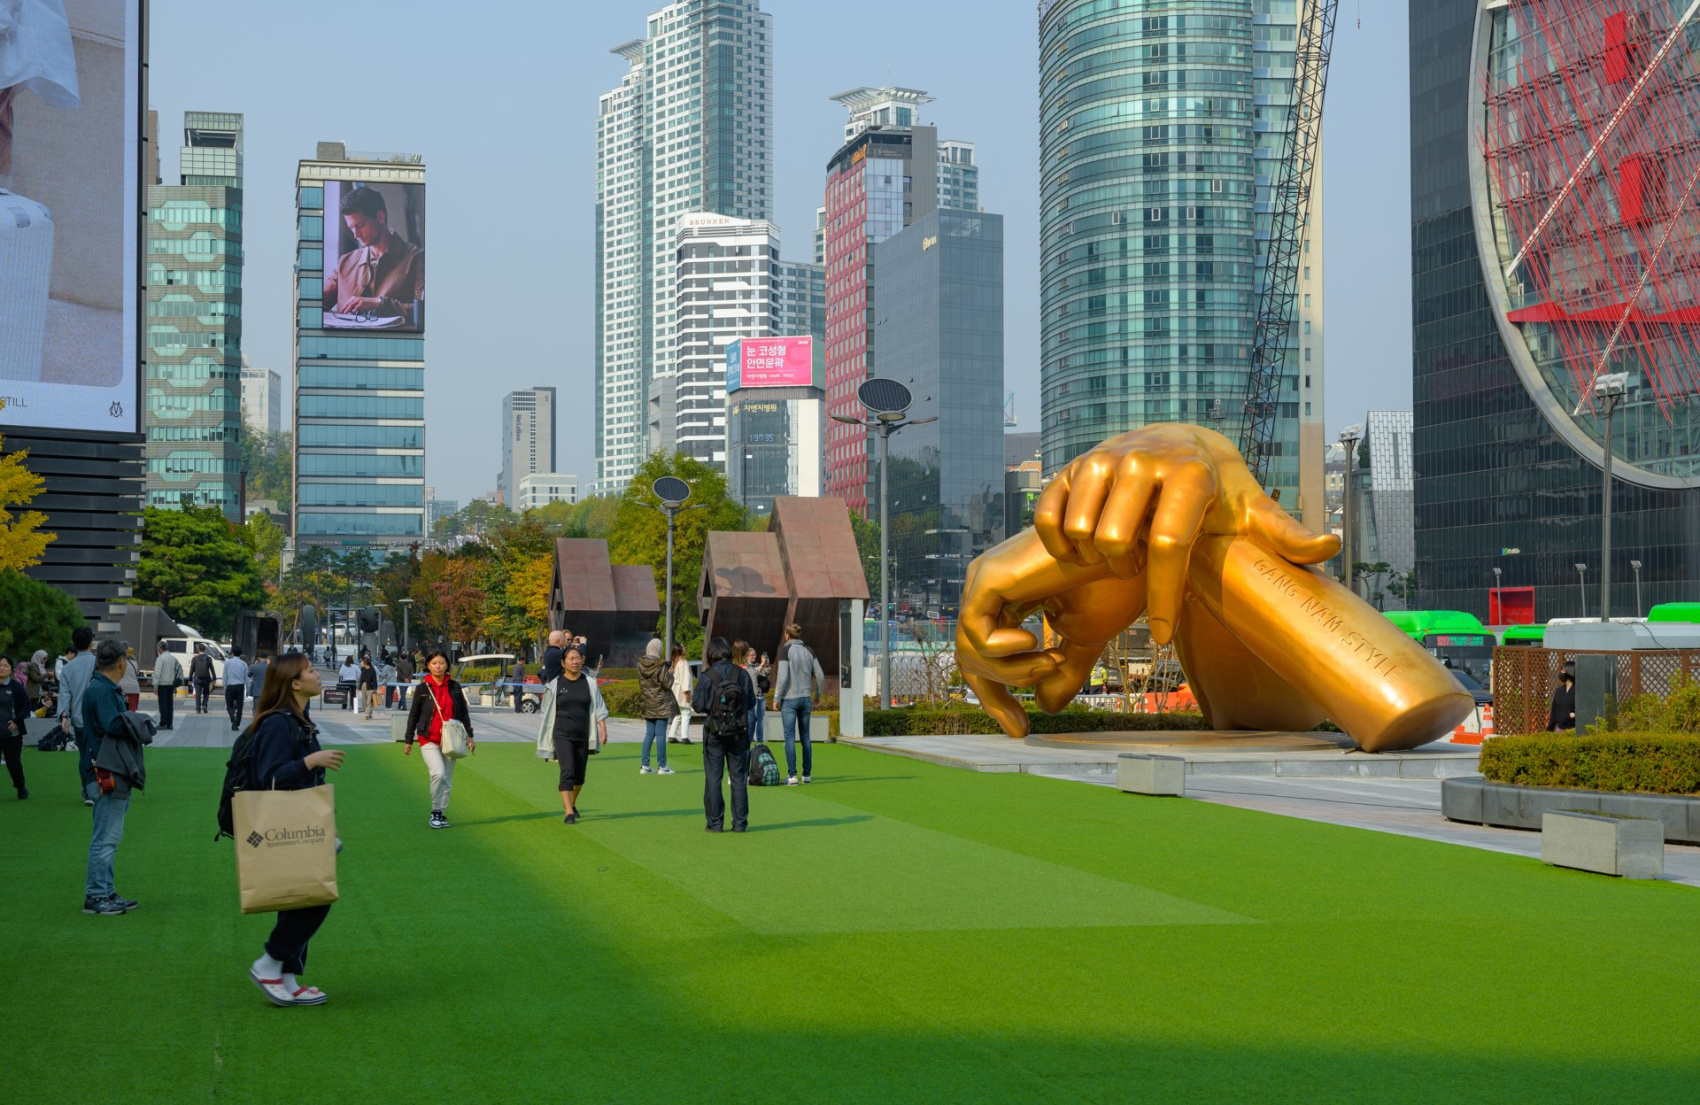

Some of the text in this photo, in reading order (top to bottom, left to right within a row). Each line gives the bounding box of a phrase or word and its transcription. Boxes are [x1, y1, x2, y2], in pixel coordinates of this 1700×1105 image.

[690, 218, 730, 226] BRUNNEN
[759, 345, 787, 357] 코성형
[747, 357, 784, 369] 안면윤곽
[1253, 559, 1403, 682] GANG NAM STYLE
[264, 826, 326, 841] Columbia
